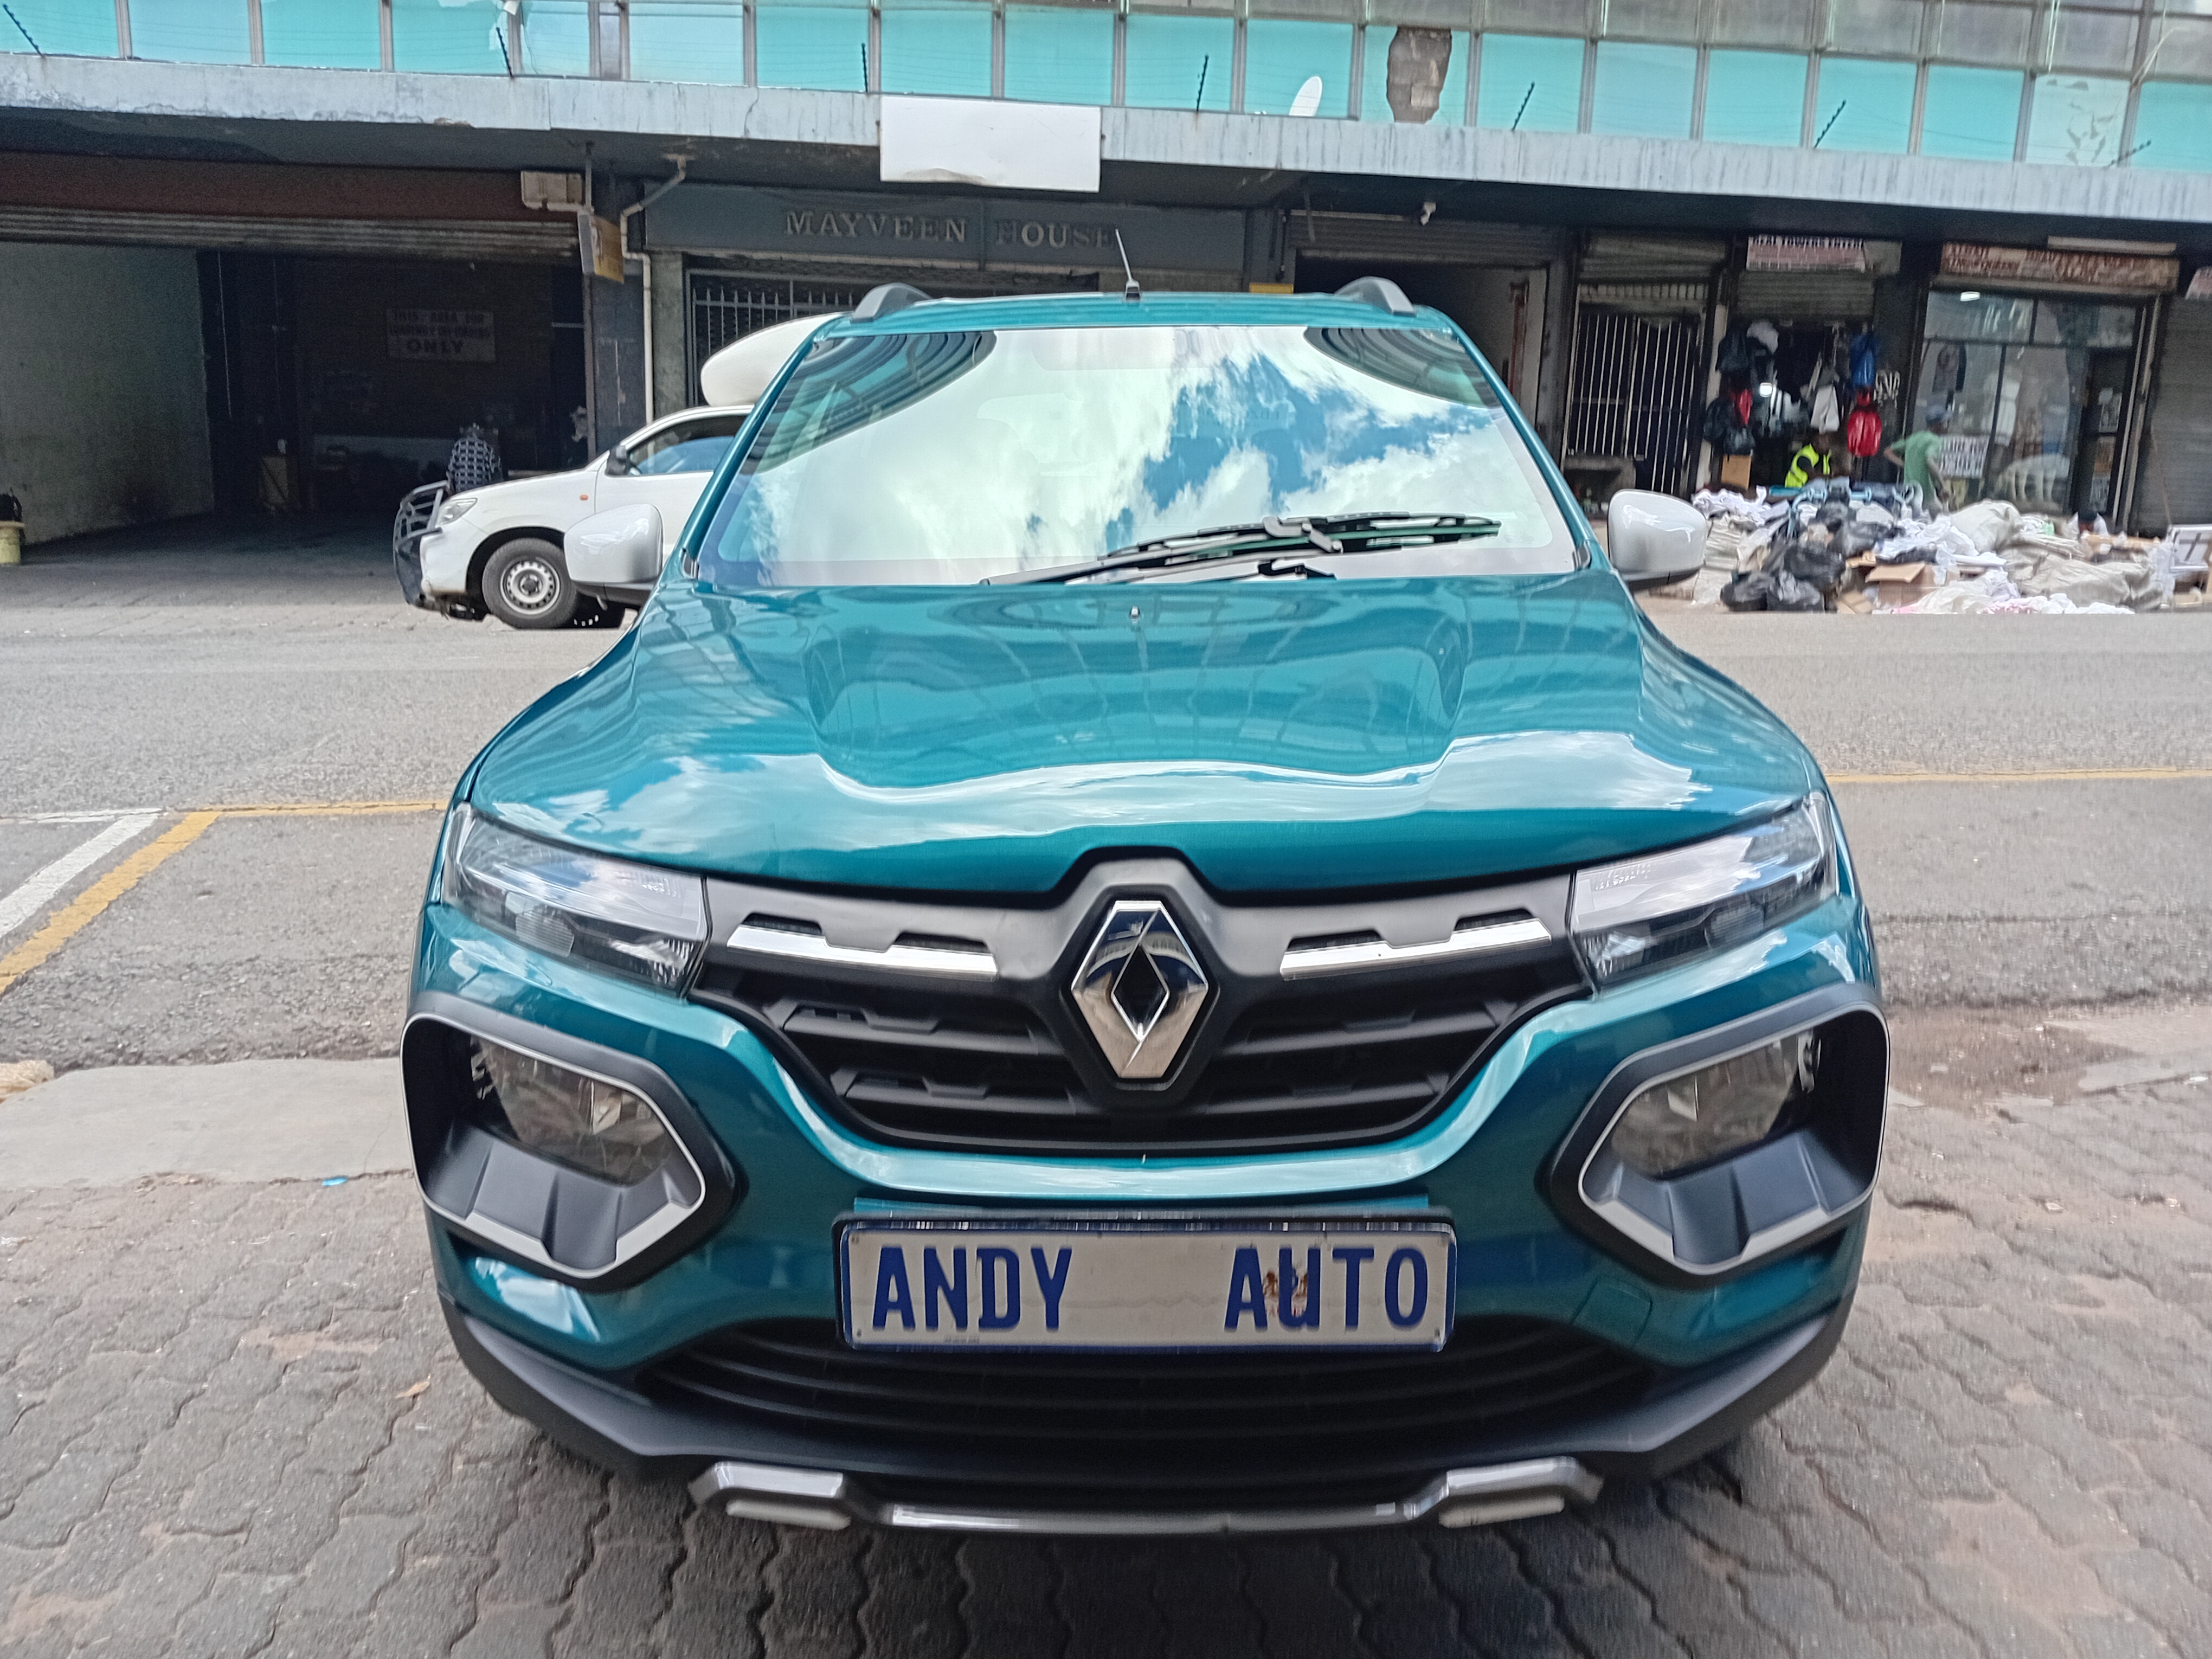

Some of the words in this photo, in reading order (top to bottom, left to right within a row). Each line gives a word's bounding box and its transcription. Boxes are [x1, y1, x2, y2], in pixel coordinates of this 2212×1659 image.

[786, 211, 966, 243] MAYVEEN
[994, 218, 1115, 248] HOUSE
[406, 338, 464, 353] ONLY
[872, 1246, 1073, 1332] ANDY
[1224, 1246, 1428, 1332] AUTO
